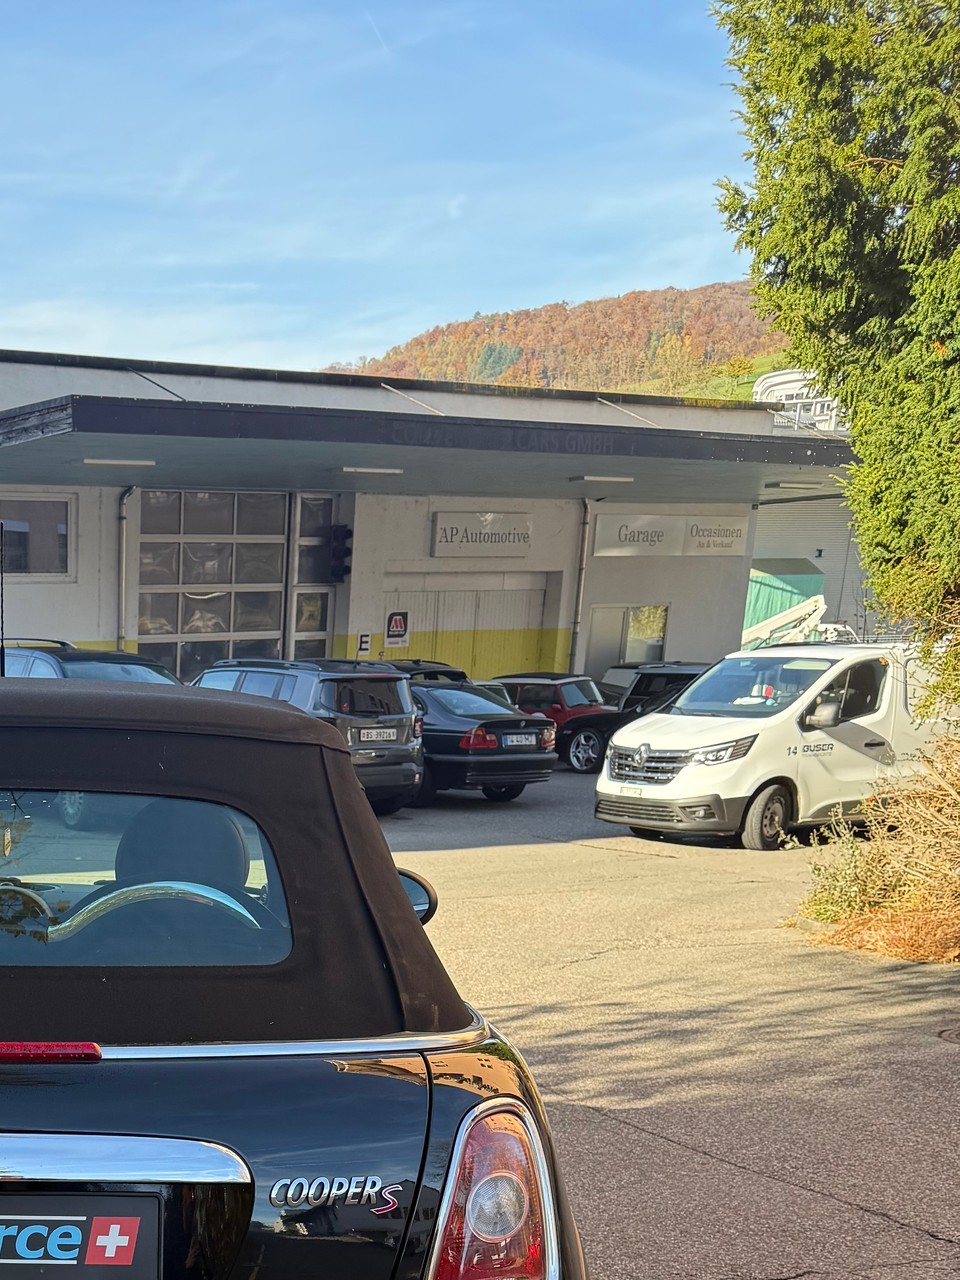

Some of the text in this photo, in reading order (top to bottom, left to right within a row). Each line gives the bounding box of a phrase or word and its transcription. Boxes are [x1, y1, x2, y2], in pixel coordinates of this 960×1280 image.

[438, 526, 530, 543] AP Automotive
[618, 524, 665, 547] Garage
[690, 523, 742, 538] Occasionen
[359, 634, 370, 651] E
[786, 745, 798, 757] 14
